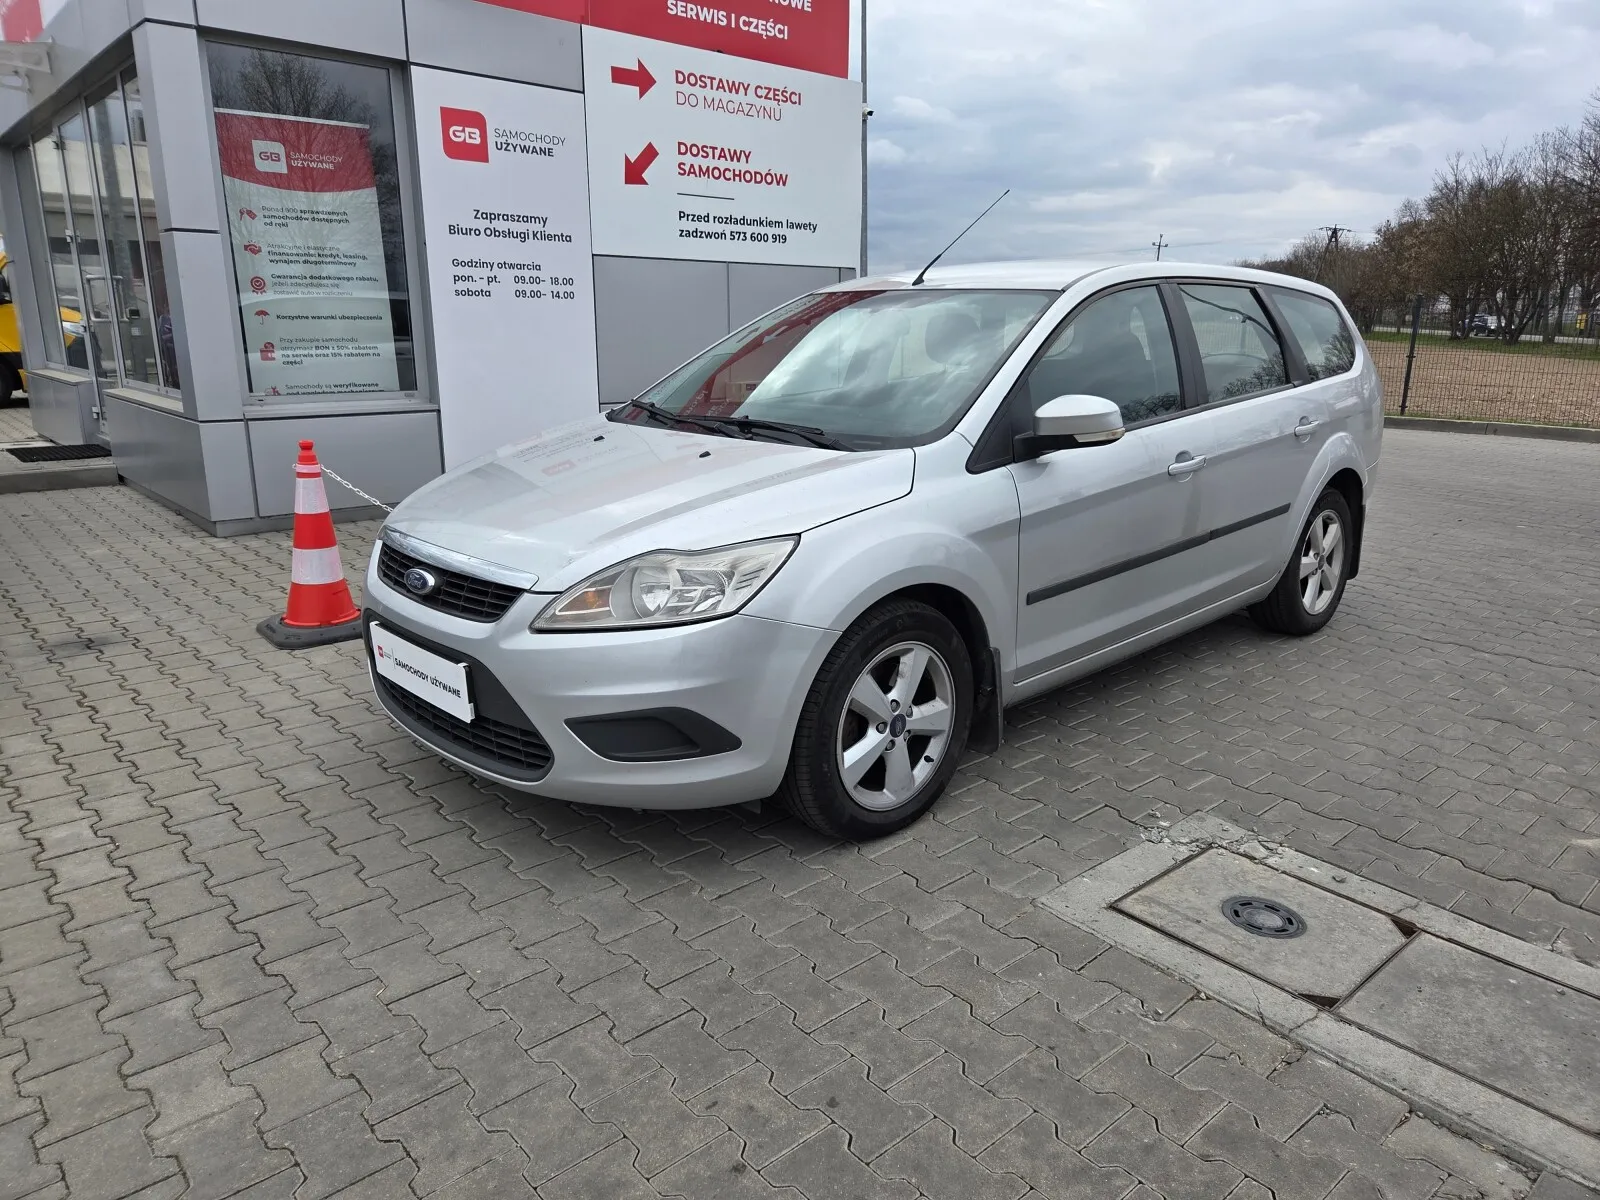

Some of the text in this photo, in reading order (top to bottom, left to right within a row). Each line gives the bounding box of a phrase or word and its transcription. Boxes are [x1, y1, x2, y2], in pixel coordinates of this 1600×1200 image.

[768, 0, 812, 12] WE
[667, 0, 788, 40] SERWIS I CZĘŚCI
[675, 70, 802, 106] DOSTAWY CZĘŚCI
[676, 91, 782, 121] DO MAGAZYNU
[449, 125, 481, 145] GB
[494, 128, 566, 146] SAMOCHODY
[495, 139, 554, 157] UŻYWANE
[677, 141, 751, 164] DOSTAWY
[259, 151, 281, 163] GB
[290, 152, 343, 163] SAMOCHODY
[291, 159, 335, 170] UŻYWANE
[677, 162, 788, 187] SAMOCHODÓW
[299, 209, 348, 217] sprawdzonych
[311, 216, 350, 224] dostępnych
[473, 209, 548, 228] Zapraszamy
[678, 211, 817, 233] Przed rozładunkiem lawety
[448, 224, 572, 243] Biuro Obsługi Klienta
[679, 228, 787, 244] zadzwoń 573 600 919
[452, 258, 541, 271] Godziny otwarcia
[453, 274, 477, 284] pon.
[487, 275, 501, 286] pt.
[550, 276, 574, 286] 18.00
[454, 288, 491, 297] sobota
[551, 290, 575, 300] 14.00
[285, 382, 323, 390] Samochody
[394, 658, 461, 698] SAMOCHODY UŻYWANE
